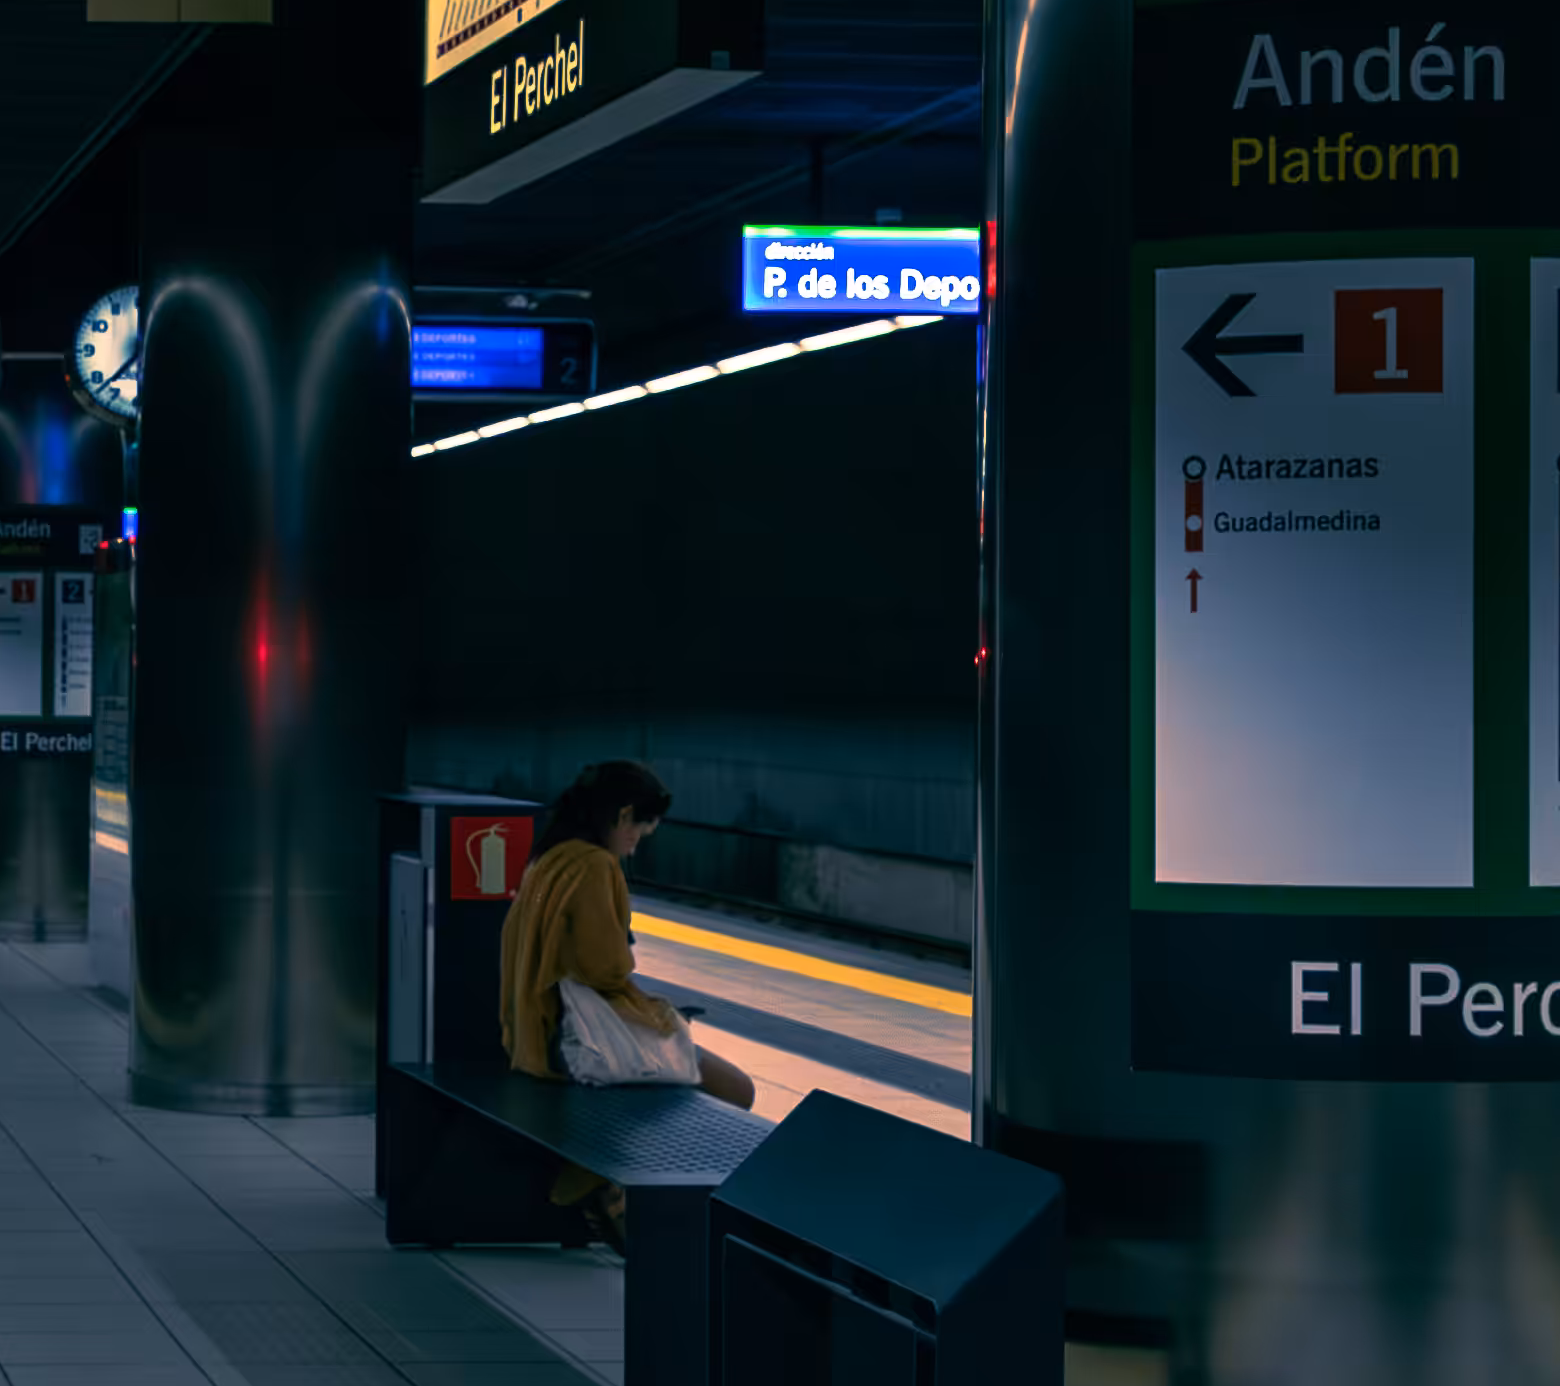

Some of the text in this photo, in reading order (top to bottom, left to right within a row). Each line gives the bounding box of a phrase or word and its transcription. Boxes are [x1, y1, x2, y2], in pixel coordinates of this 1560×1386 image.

[490, 16, 585, 136] El Perchel
[1233, 21, 1506, 110] Andén
[1231, 132, 1459, 186] Platform
[763, 266, 788, 299] P.
[797, 267, 837, 299] de
[846, 267, 890, 300] los
[84, 344, 95, 357] 9
[1372, 307, 1408, 380] 1
[1216, 455, 1379, 481] Atarazanas
[1214, 510, 1381, 533] Guadalmedina
[68, 582, 80, 600] 2
[0, 728, 92, 752] El Perchel
[1289, 959, 1364, 1037] El
